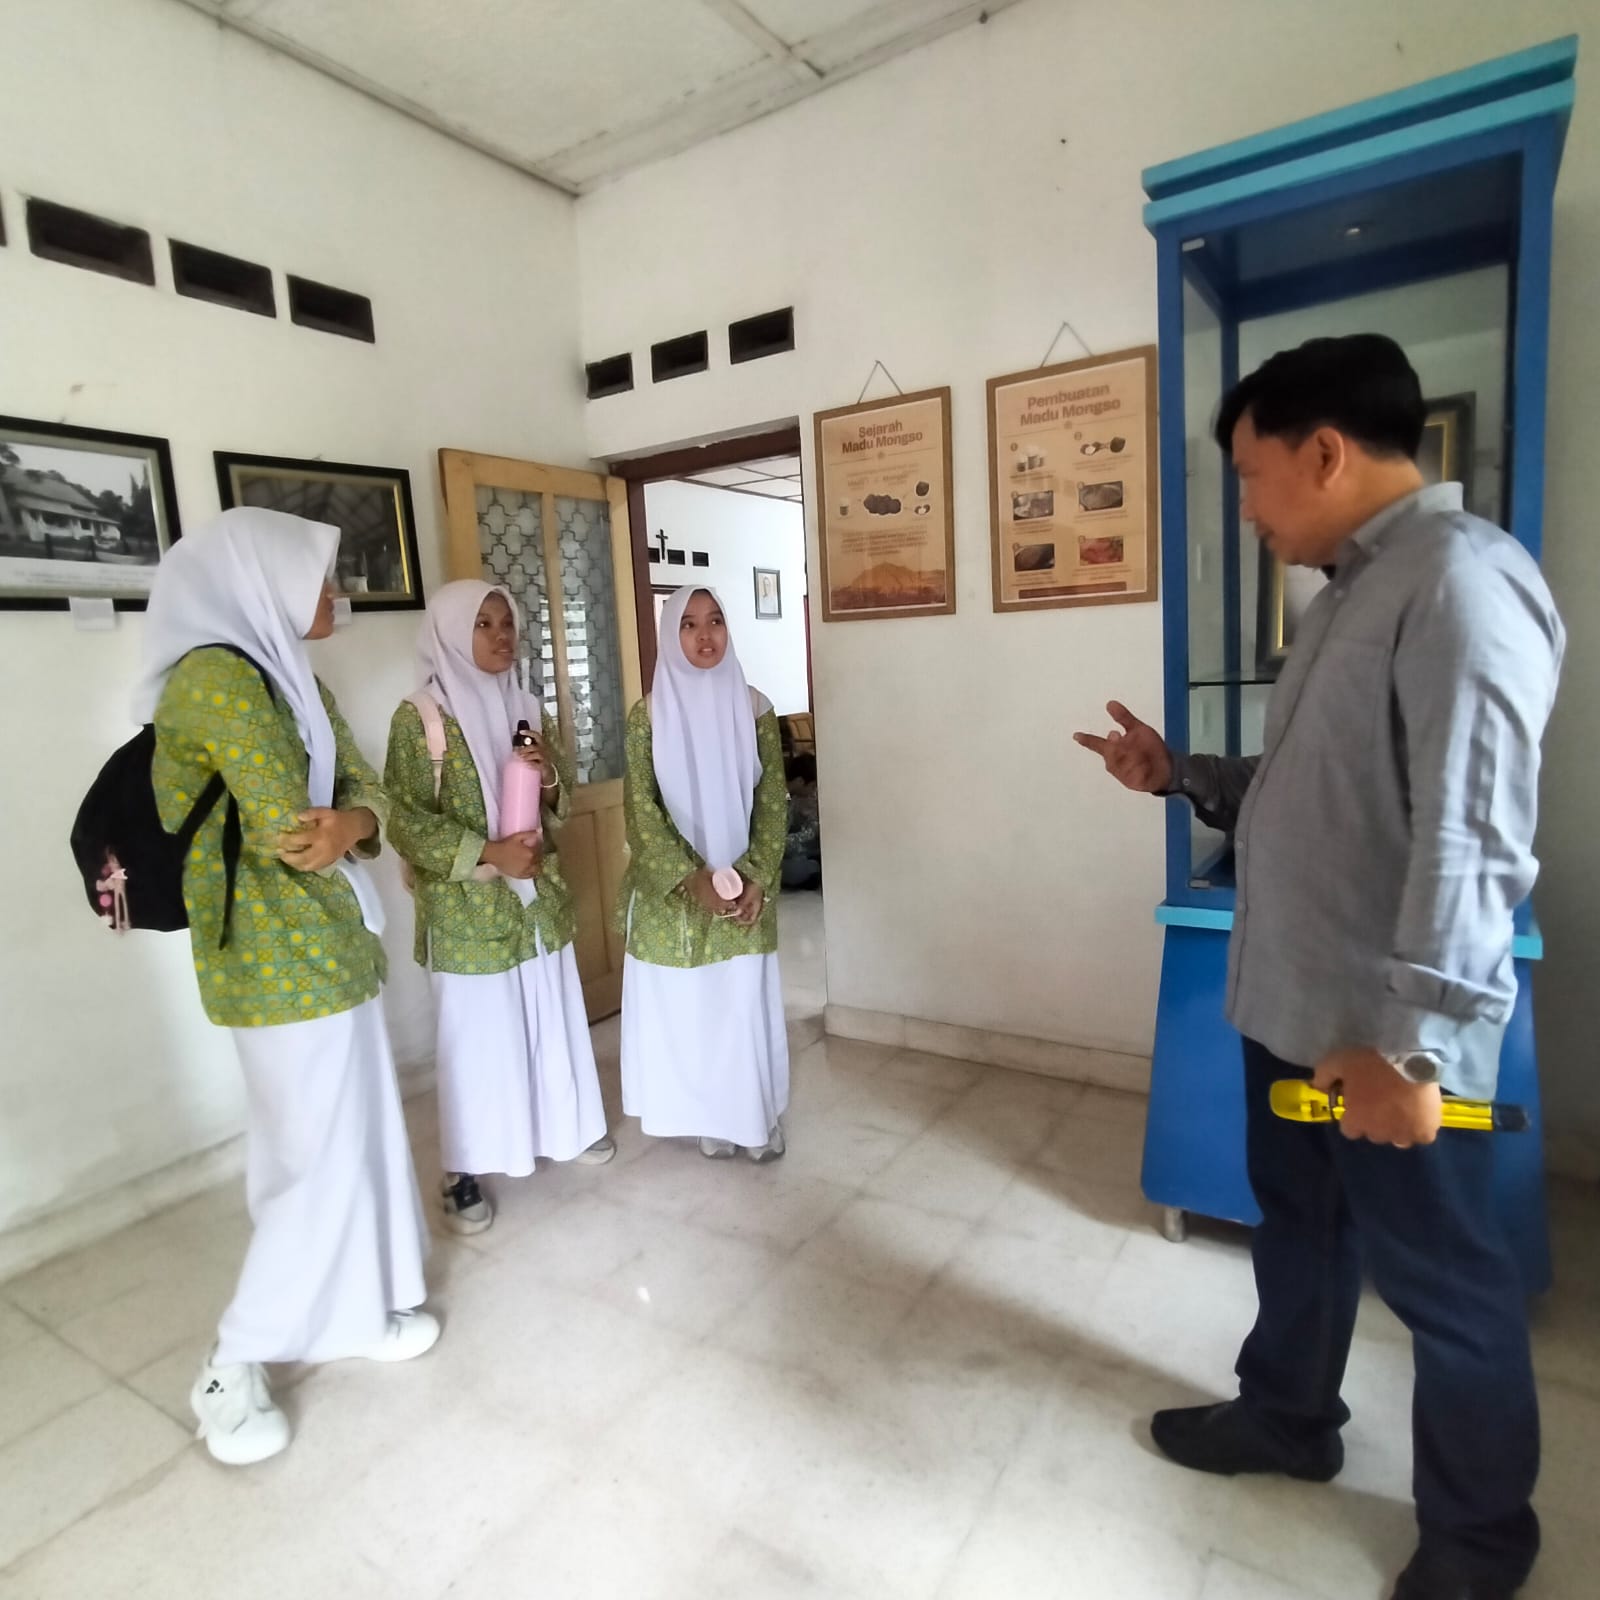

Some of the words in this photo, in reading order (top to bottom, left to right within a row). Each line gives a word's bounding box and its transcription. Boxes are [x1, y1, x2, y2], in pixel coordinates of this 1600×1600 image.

[1027, 384, 1110, 409] Pembuatan
[1020, 408, 1059, 426] Madu
[1062, 398, 1120, 418] Mongso
[858, 419, 903, 438] Sejarah
[842, 439, 873, 454] Madu
[876, 432, 923, 448] Mongso
